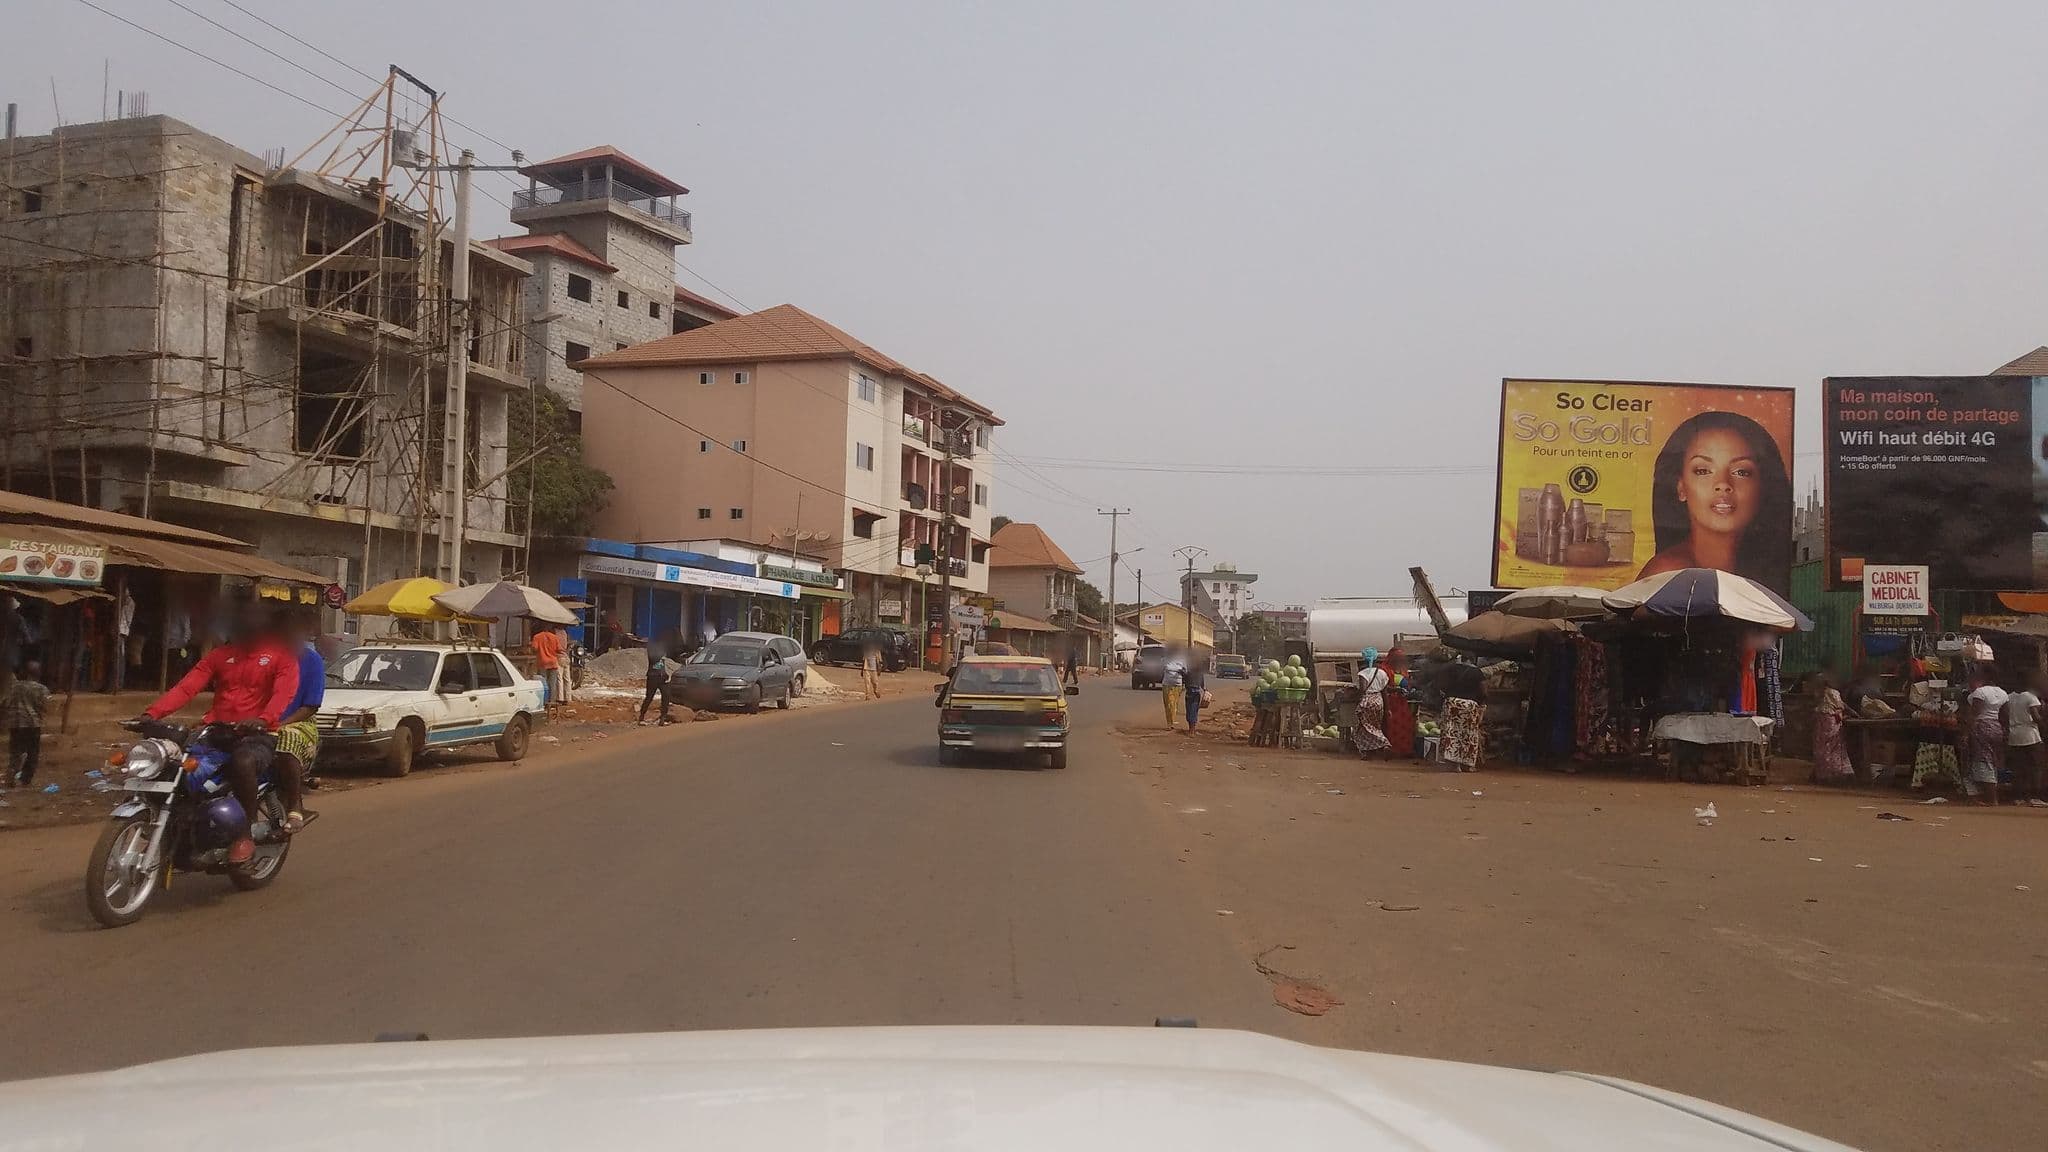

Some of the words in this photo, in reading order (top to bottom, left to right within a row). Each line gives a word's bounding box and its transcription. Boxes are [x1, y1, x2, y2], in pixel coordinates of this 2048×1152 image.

[1556, 392, 1585, 410] So
[1592, 393, 1653, 412] Clear
[1839, 389, 1865, 404] Ma
[1870, 389, 1939, 406] maison,
[1839, 409, 1878, 421] mon
[1884, 407, 1921, 421] coin
[1926, 407, 1948, 422] de
[1953, 408, 2020, 425] partage
[1513, 412, 1560, 442] So
[1569, 414, 1653, 445] Gold
[1839, 430, 1873, 445] Wifi
[1878, 430, 1917, 445] haut
[1922, 430, 1967, 445] débit
[1970, 431, 1996, 446] 4G
[1532, 445, 1559, 457] Pour
[1560, 449, 1575, 457] un
[1577, 447, 1603, 459] teint
[1605, 450, 1619, 459] en
[1621, 450, 1634, 459] or
[1888, 455, 1910, 464] partir
[9, 539, 104, 558] RESTAURANT
[1871, 571, 1920, 585] CABINET
[1871, 586, 1921, 600] MEDICAL
